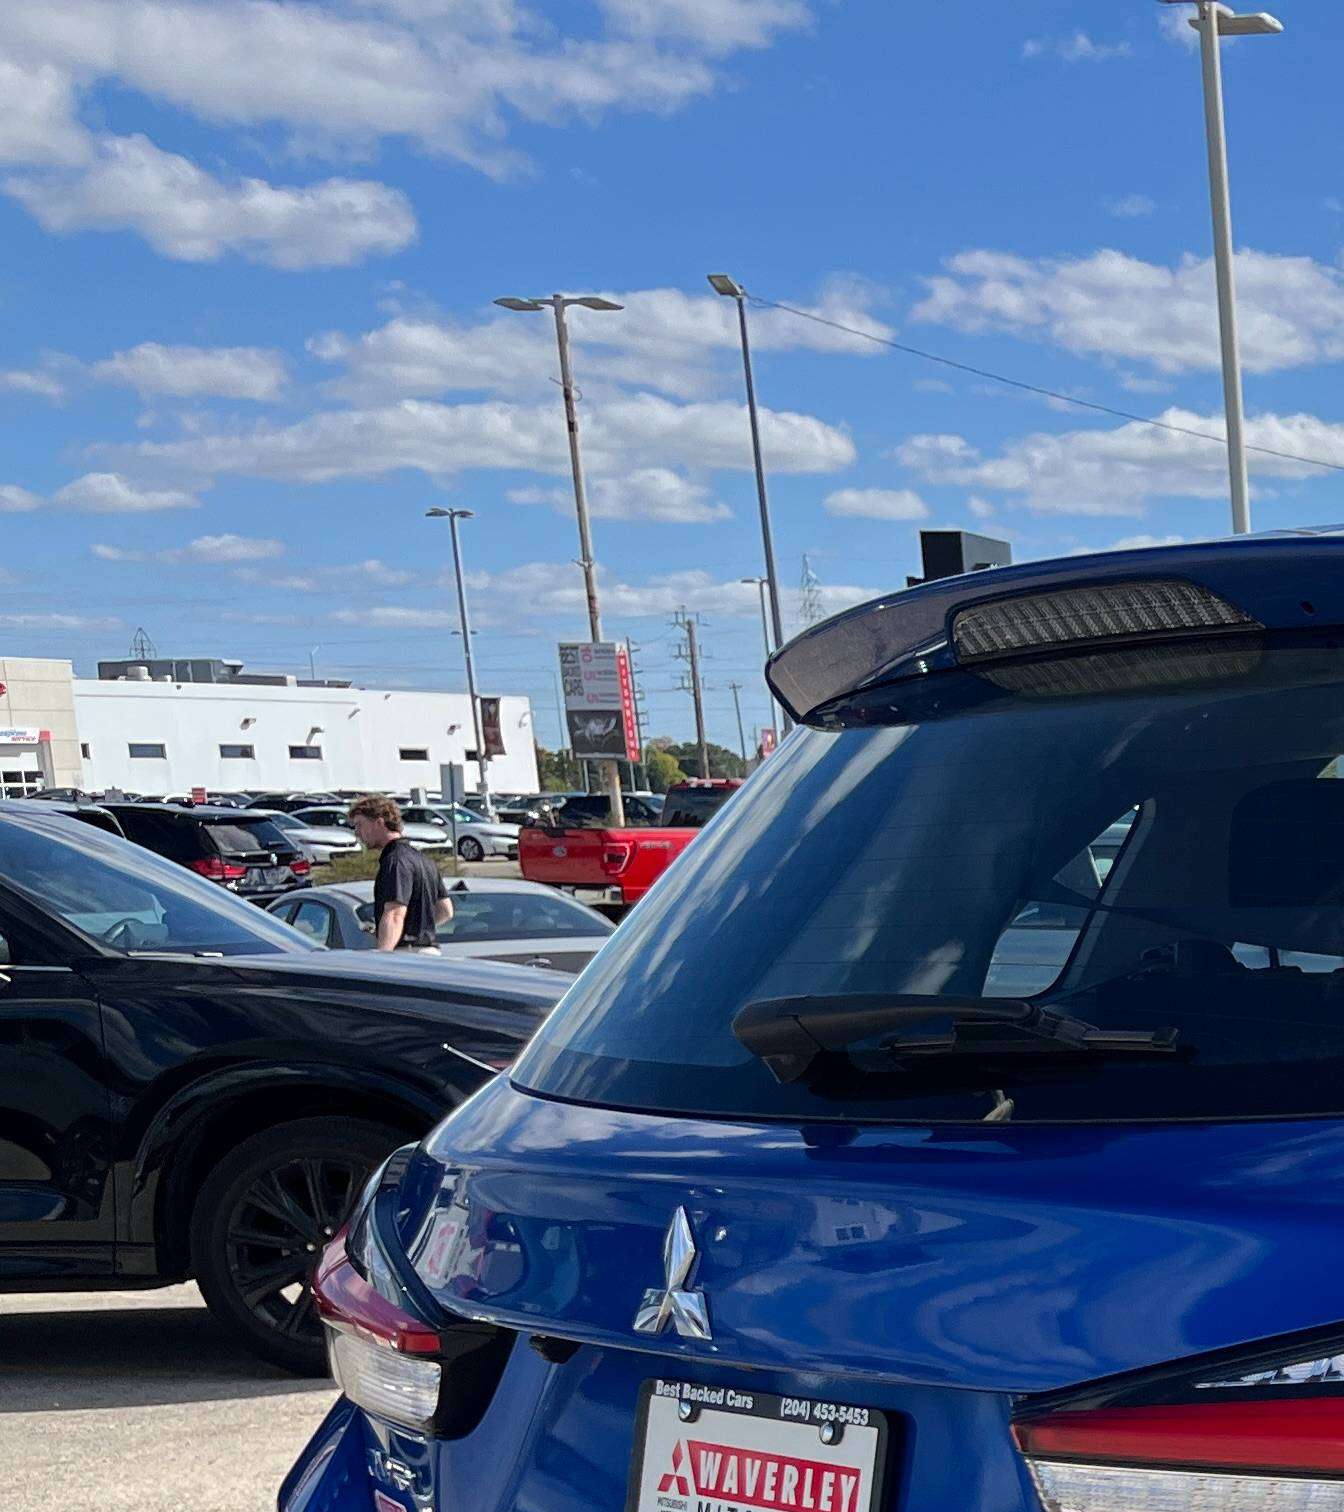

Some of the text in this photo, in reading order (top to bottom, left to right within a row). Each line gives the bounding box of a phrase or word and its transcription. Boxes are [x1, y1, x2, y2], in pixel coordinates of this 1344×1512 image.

[655, 1379, 870, 1426] Best Backed Cars (204) 453-5453
